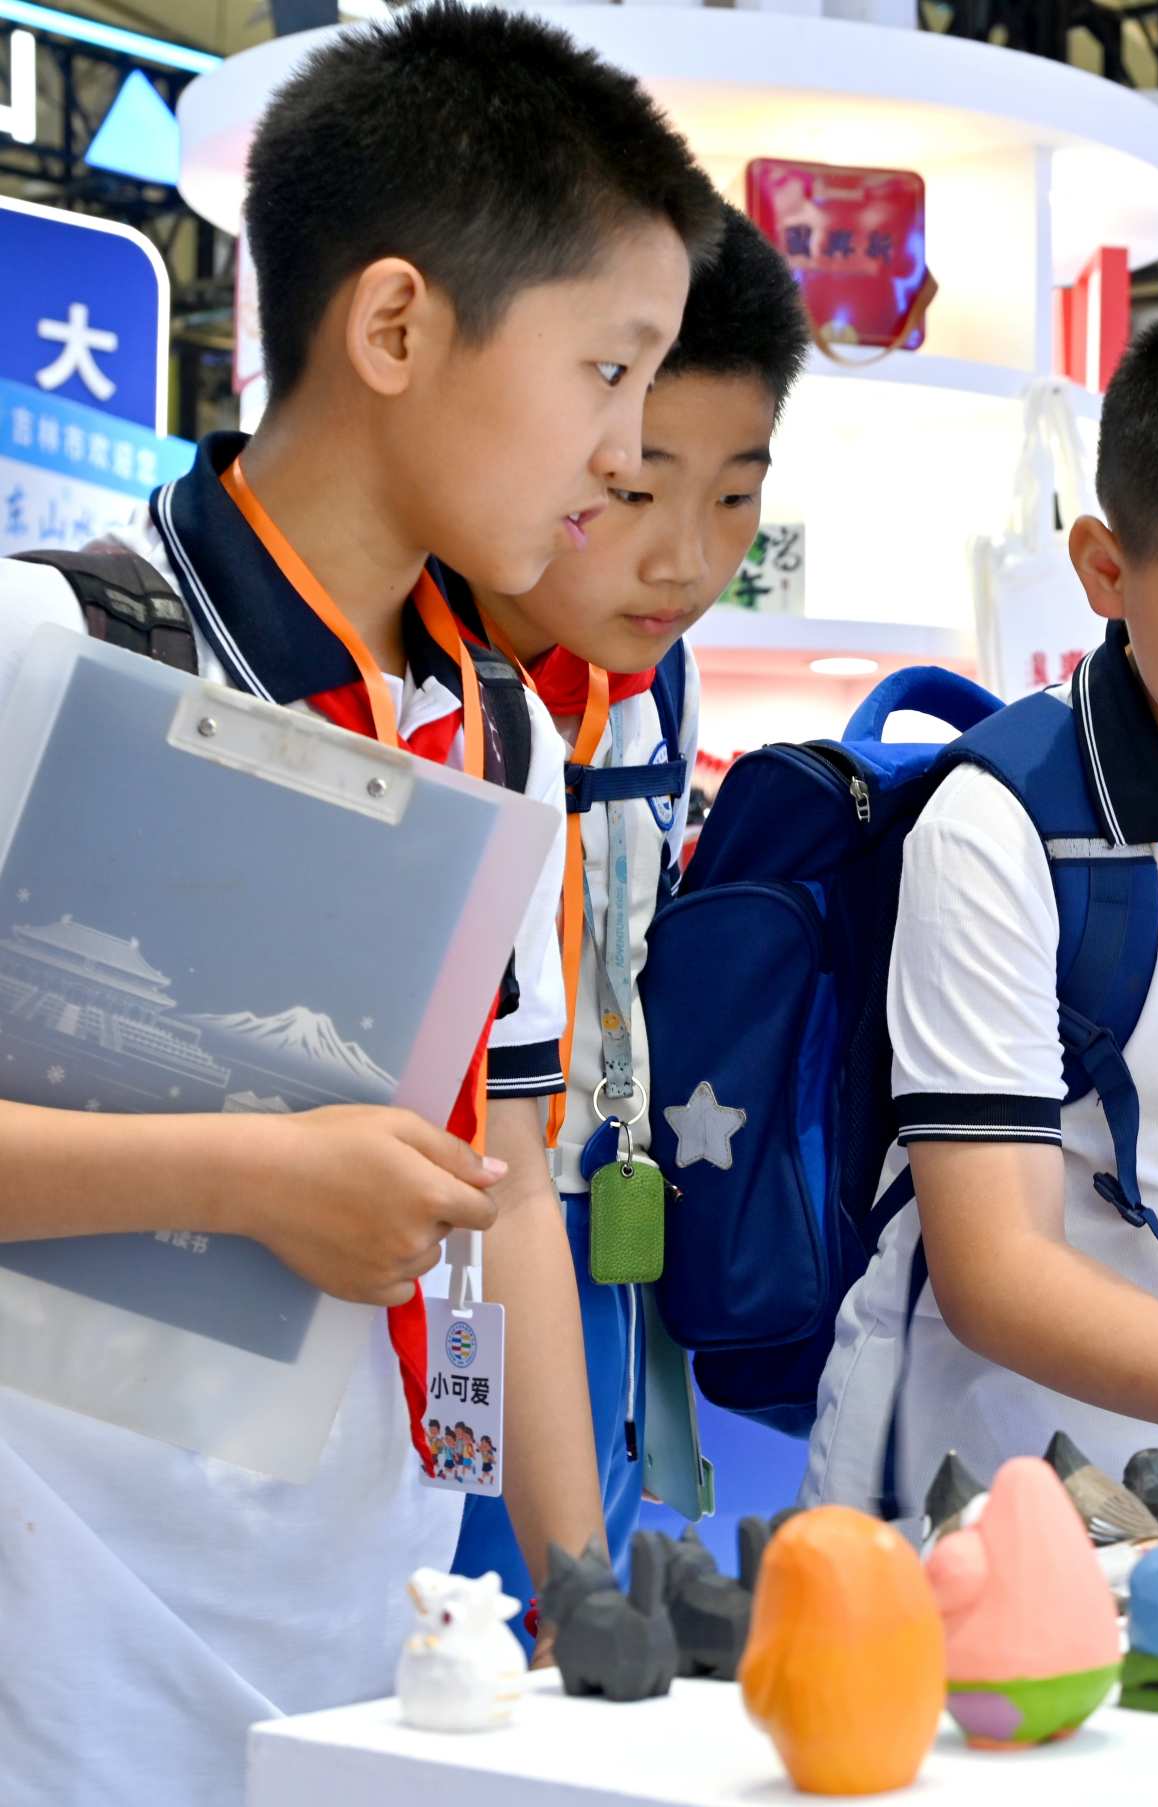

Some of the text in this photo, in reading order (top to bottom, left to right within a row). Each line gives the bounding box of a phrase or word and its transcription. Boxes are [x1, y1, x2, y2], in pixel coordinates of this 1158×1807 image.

[36, 302, 118, 401] 大
[430, 1371, 490, 1406] 小可爱
